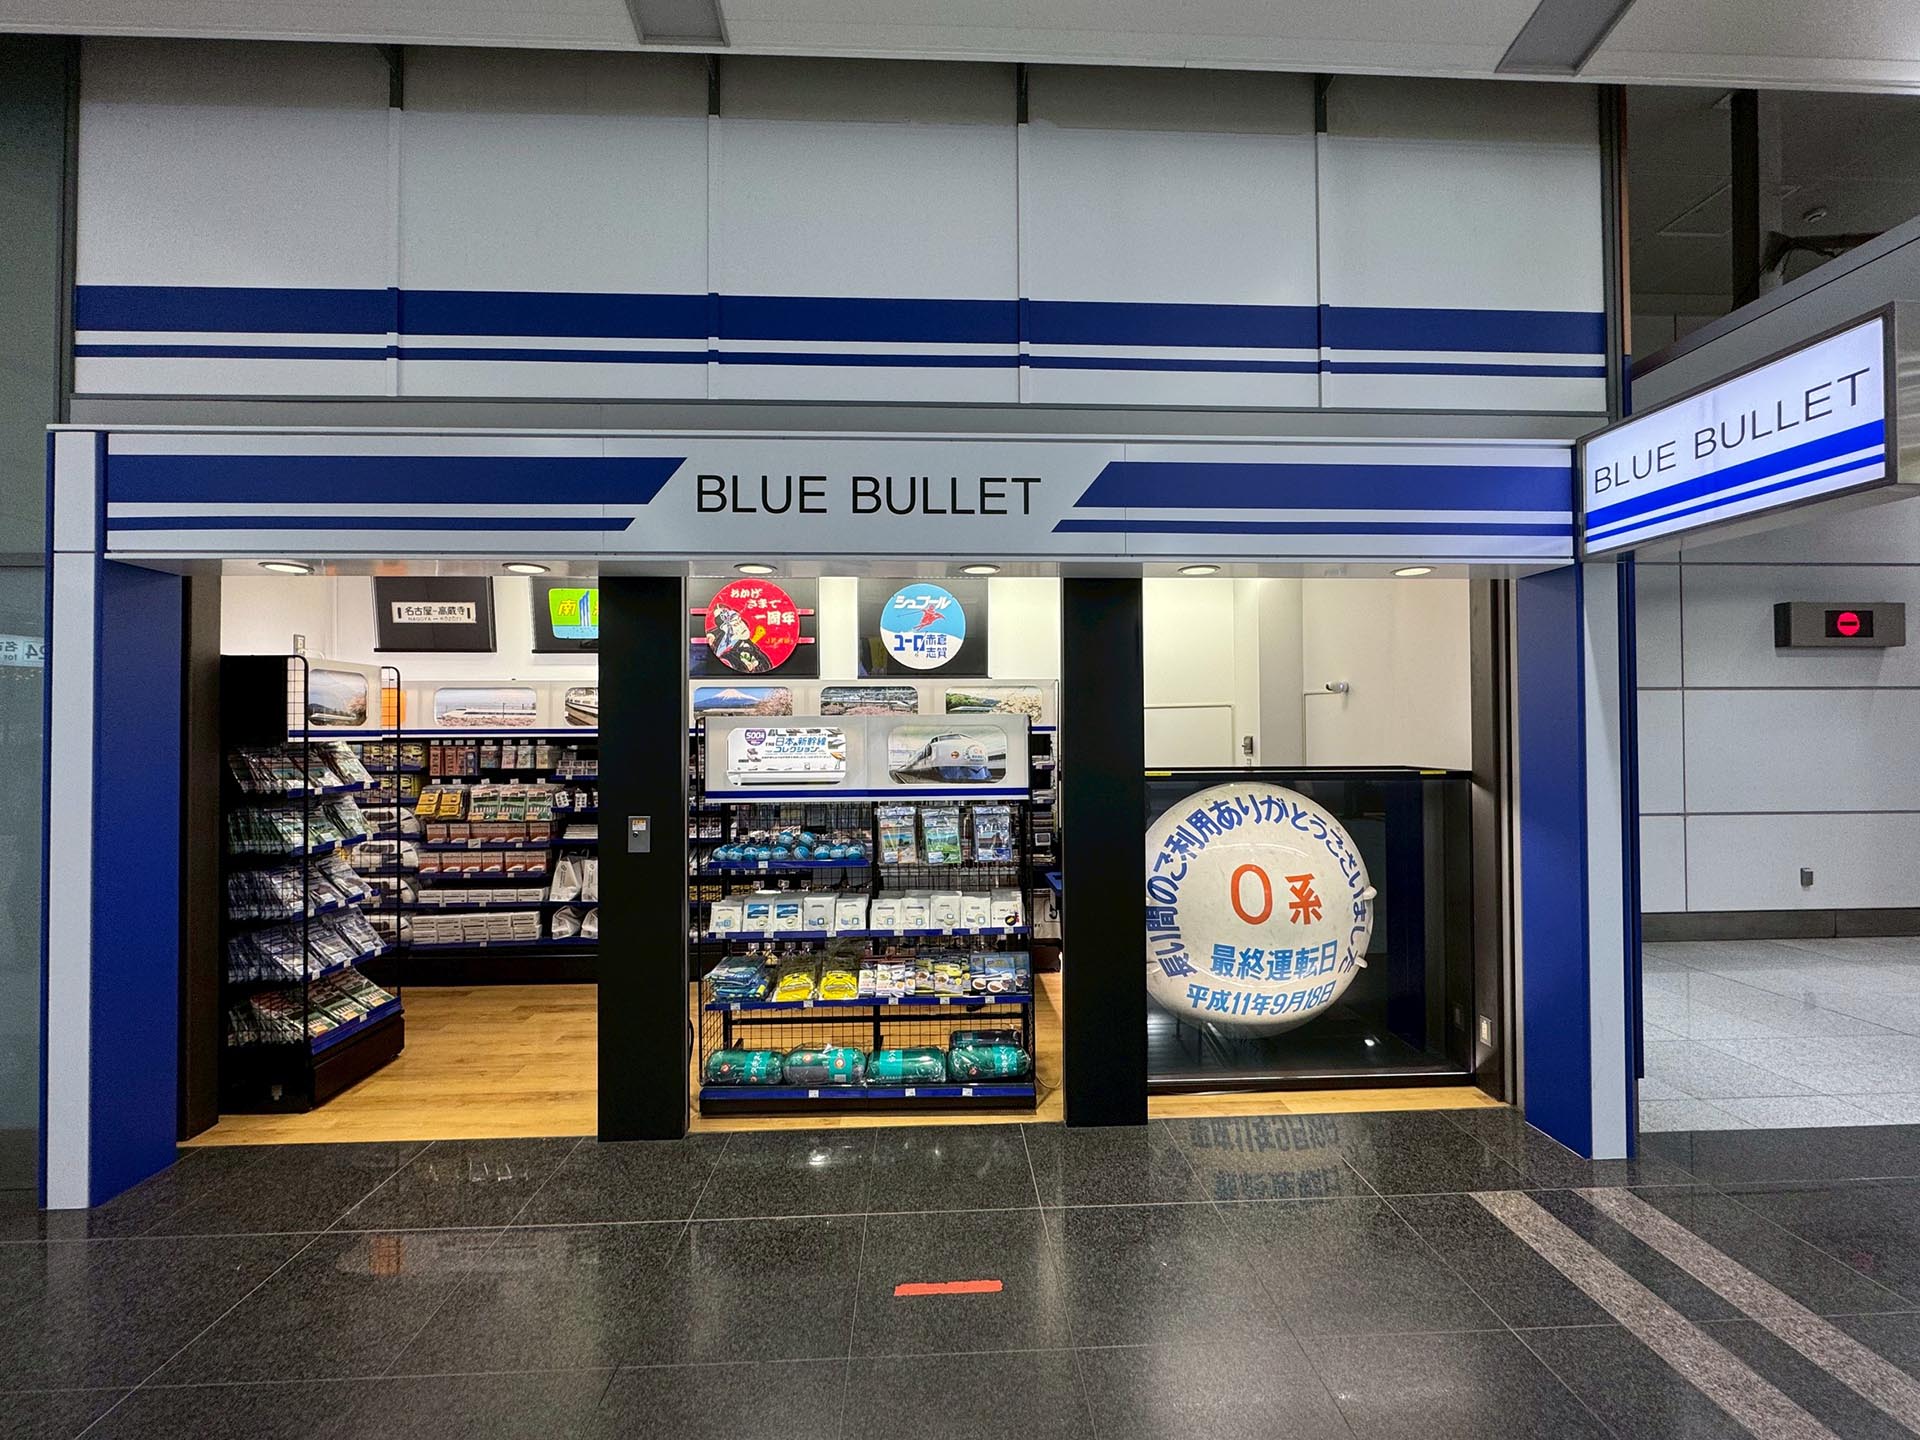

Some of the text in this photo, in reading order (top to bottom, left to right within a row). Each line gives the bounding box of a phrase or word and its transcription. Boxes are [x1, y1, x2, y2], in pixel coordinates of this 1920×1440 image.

[1594, 367, 1871, 495] BLUE BULLET
[696, 475, 1042, 516] BLUE BULLET
[754, 610, 796, 626] 一周年
[893, 634, 926, 652] ユーロ
[925, 646, 948, 660] 志賀
[773, 746, 820, 754] コレクション
[1209, 939, 1339, 981] 最終運転日
[1186, 980, 1337, 1016] 平成11年9月18日
